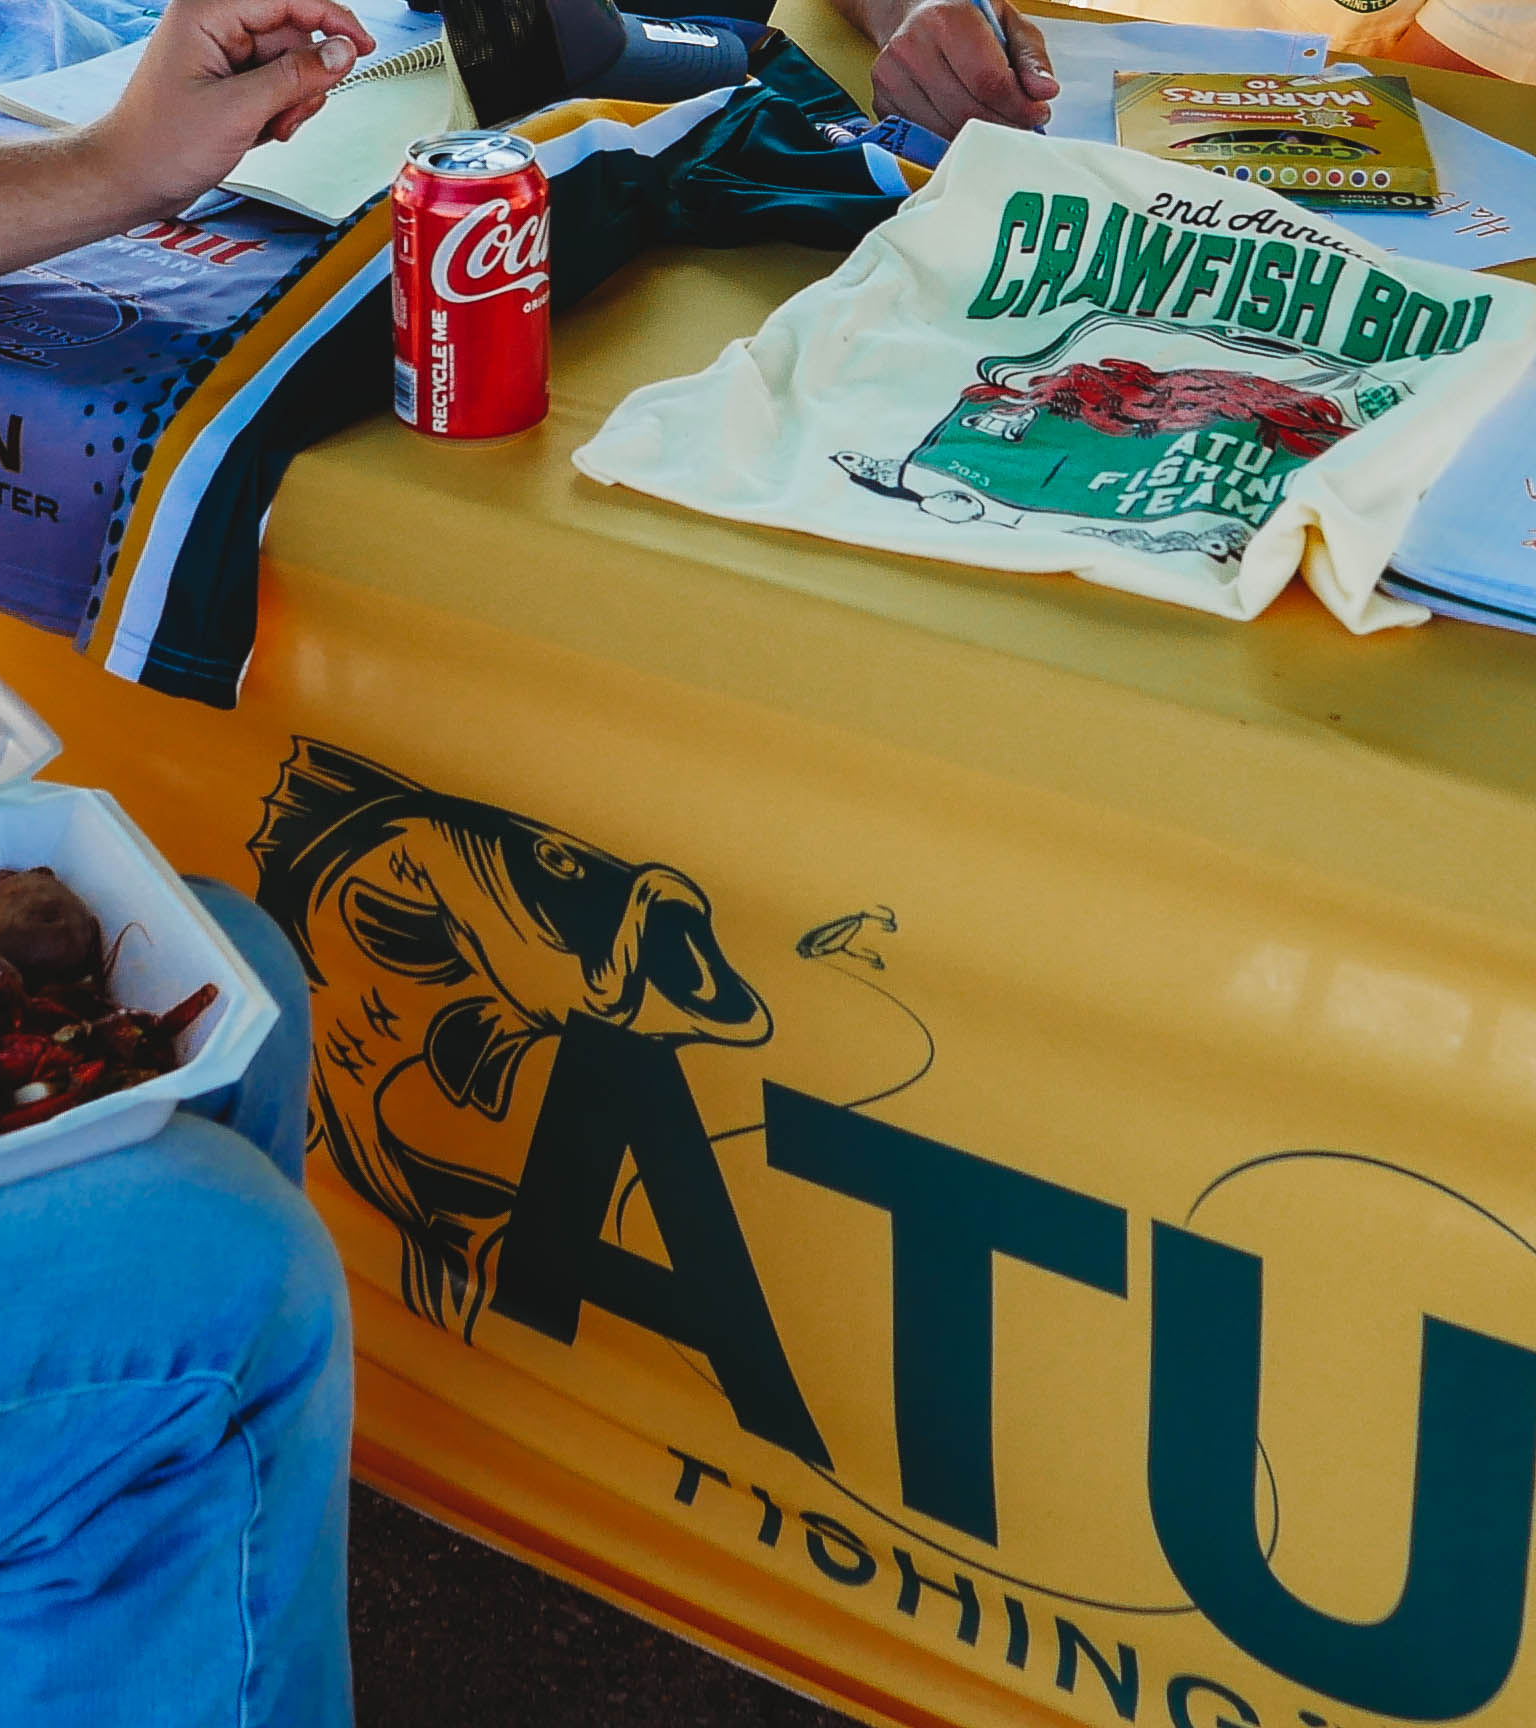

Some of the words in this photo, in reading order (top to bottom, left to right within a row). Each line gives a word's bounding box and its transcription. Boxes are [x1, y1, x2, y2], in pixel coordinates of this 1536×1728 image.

[1162, 86, 1372, 108] MARKERS
[1247, 79, 1279, 90] 10
[1191, 142, 1365, 161] Crayola
[1148, 192, 1221, 229] 2nd
[967, 191, 1346, 345] CRAWFISH
[431, 309, 448, 343] ME
[431, 344, 449, 433] RECYCLE
[1167, 431, 1274, 476] ATU
[946, 459, 992, 488] 2023
[1114, 481, 1272, 526] TEAM
